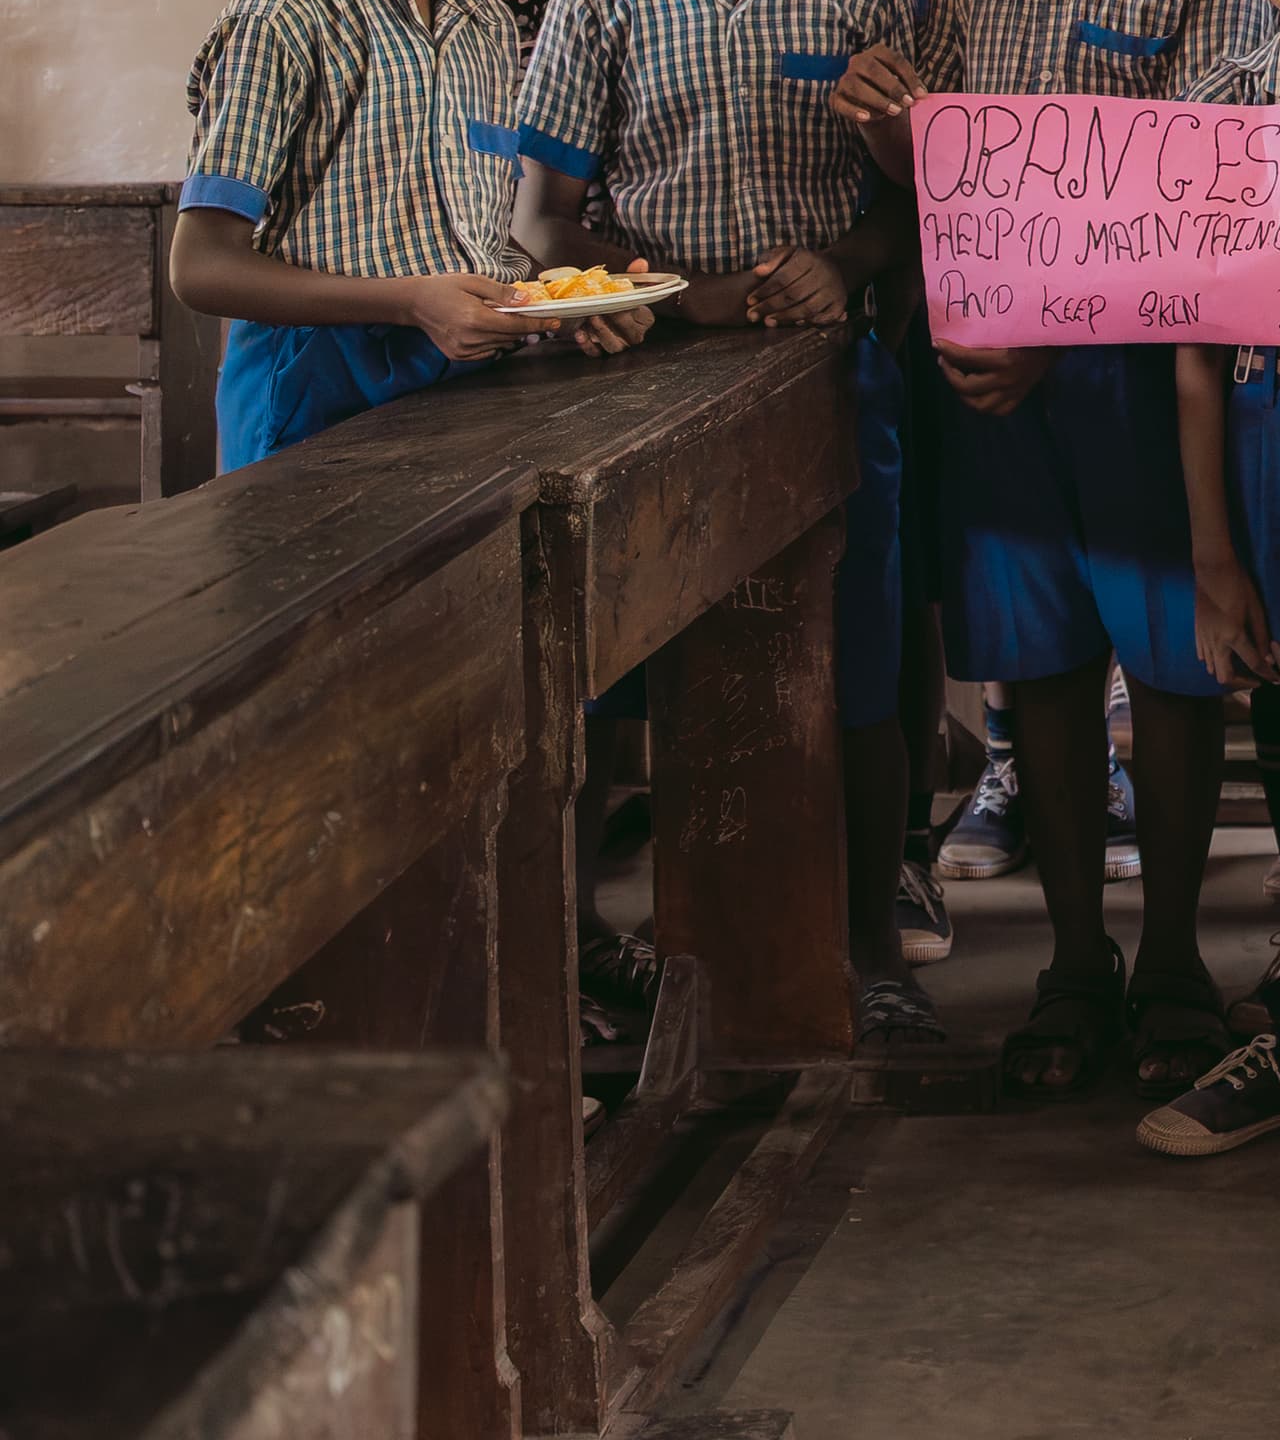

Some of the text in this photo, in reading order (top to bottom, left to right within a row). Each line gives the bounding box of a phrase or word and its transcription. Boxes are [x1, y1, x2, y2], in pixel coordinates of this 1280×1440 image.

[923, 206, 1015, 262] HELP
[1019, 211, 1061, 268] TO
[939, 269, 1014, 323] AND
[1041, 284, 1107, 335] KEEP
[1138, 290, 1201, 328] SKIN
